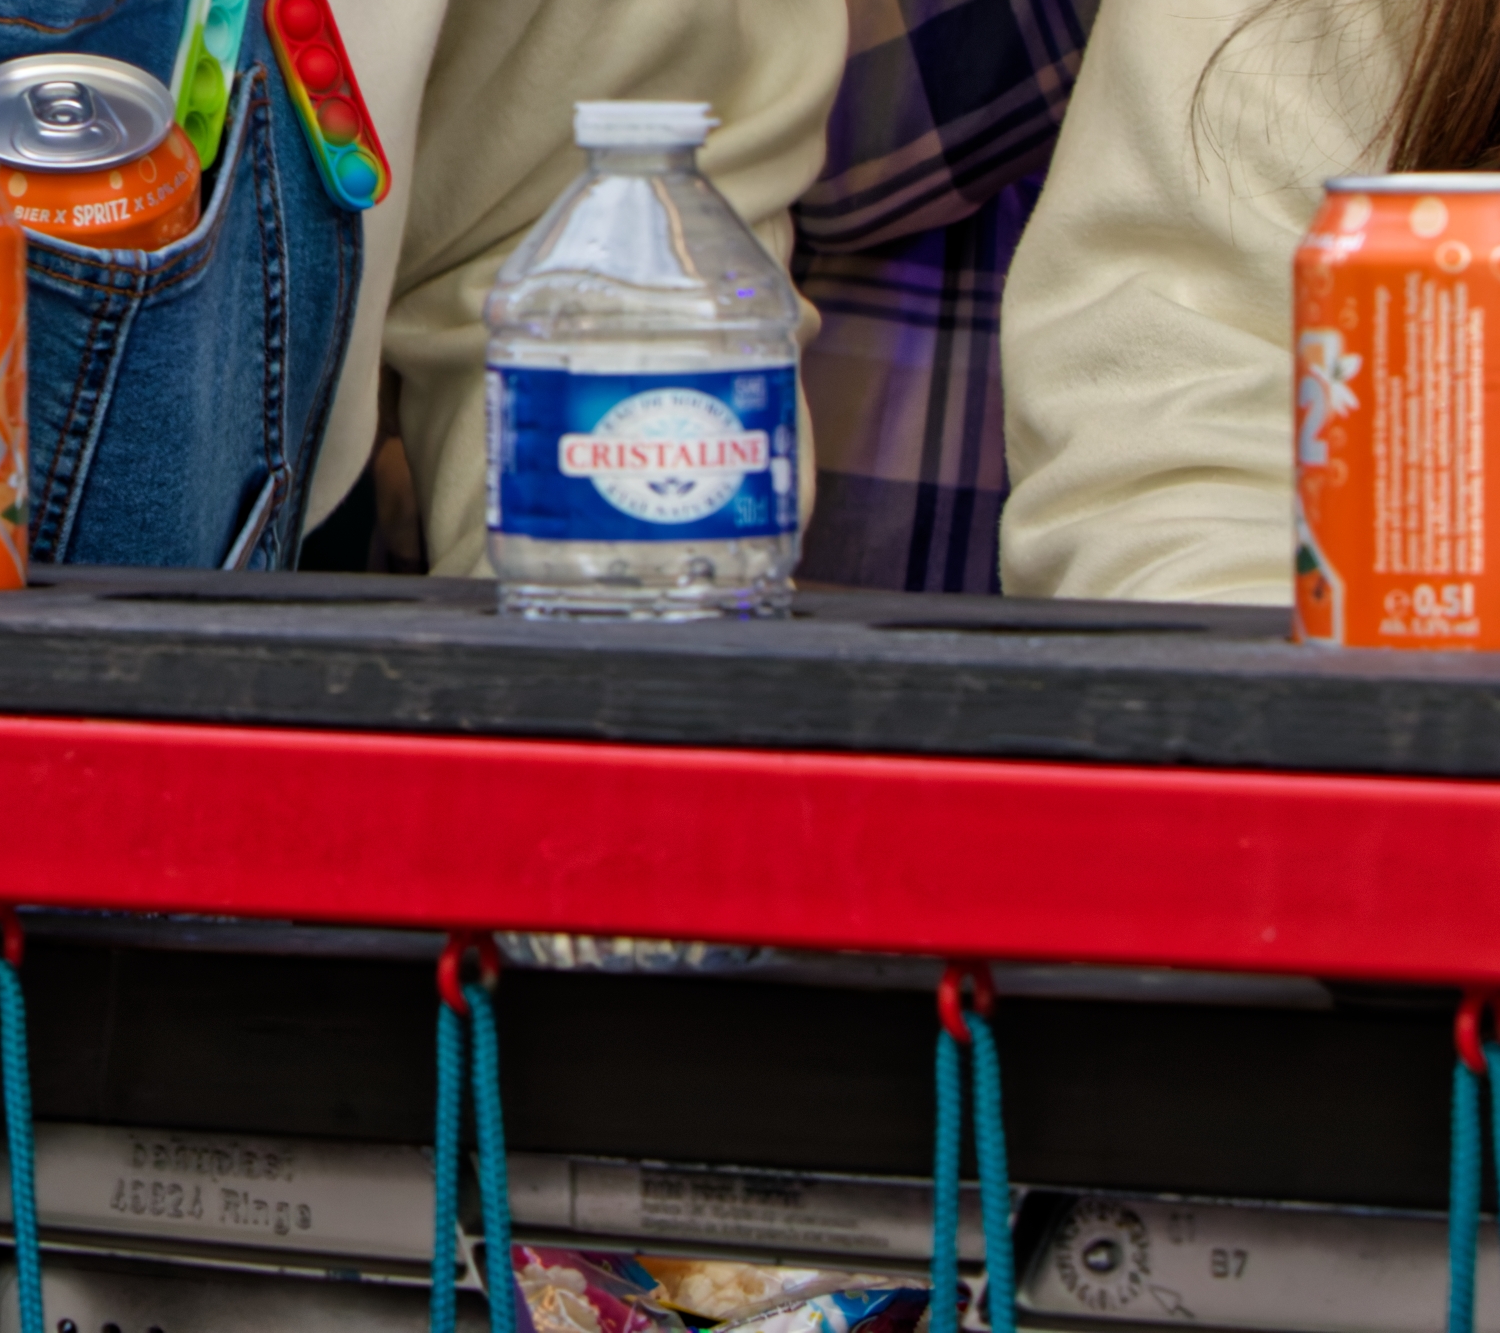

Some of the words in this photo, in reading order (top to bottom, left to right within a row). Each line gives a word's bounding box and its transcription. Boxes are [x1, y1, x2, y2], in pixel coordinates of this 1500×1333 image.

[13, 204, 50, 224] BIER
[72, 198, 132, 228] SPRITZ
[564, 437, 765, 471] CRISTALINE
[220, 1186, 312, 1237] Ringe
